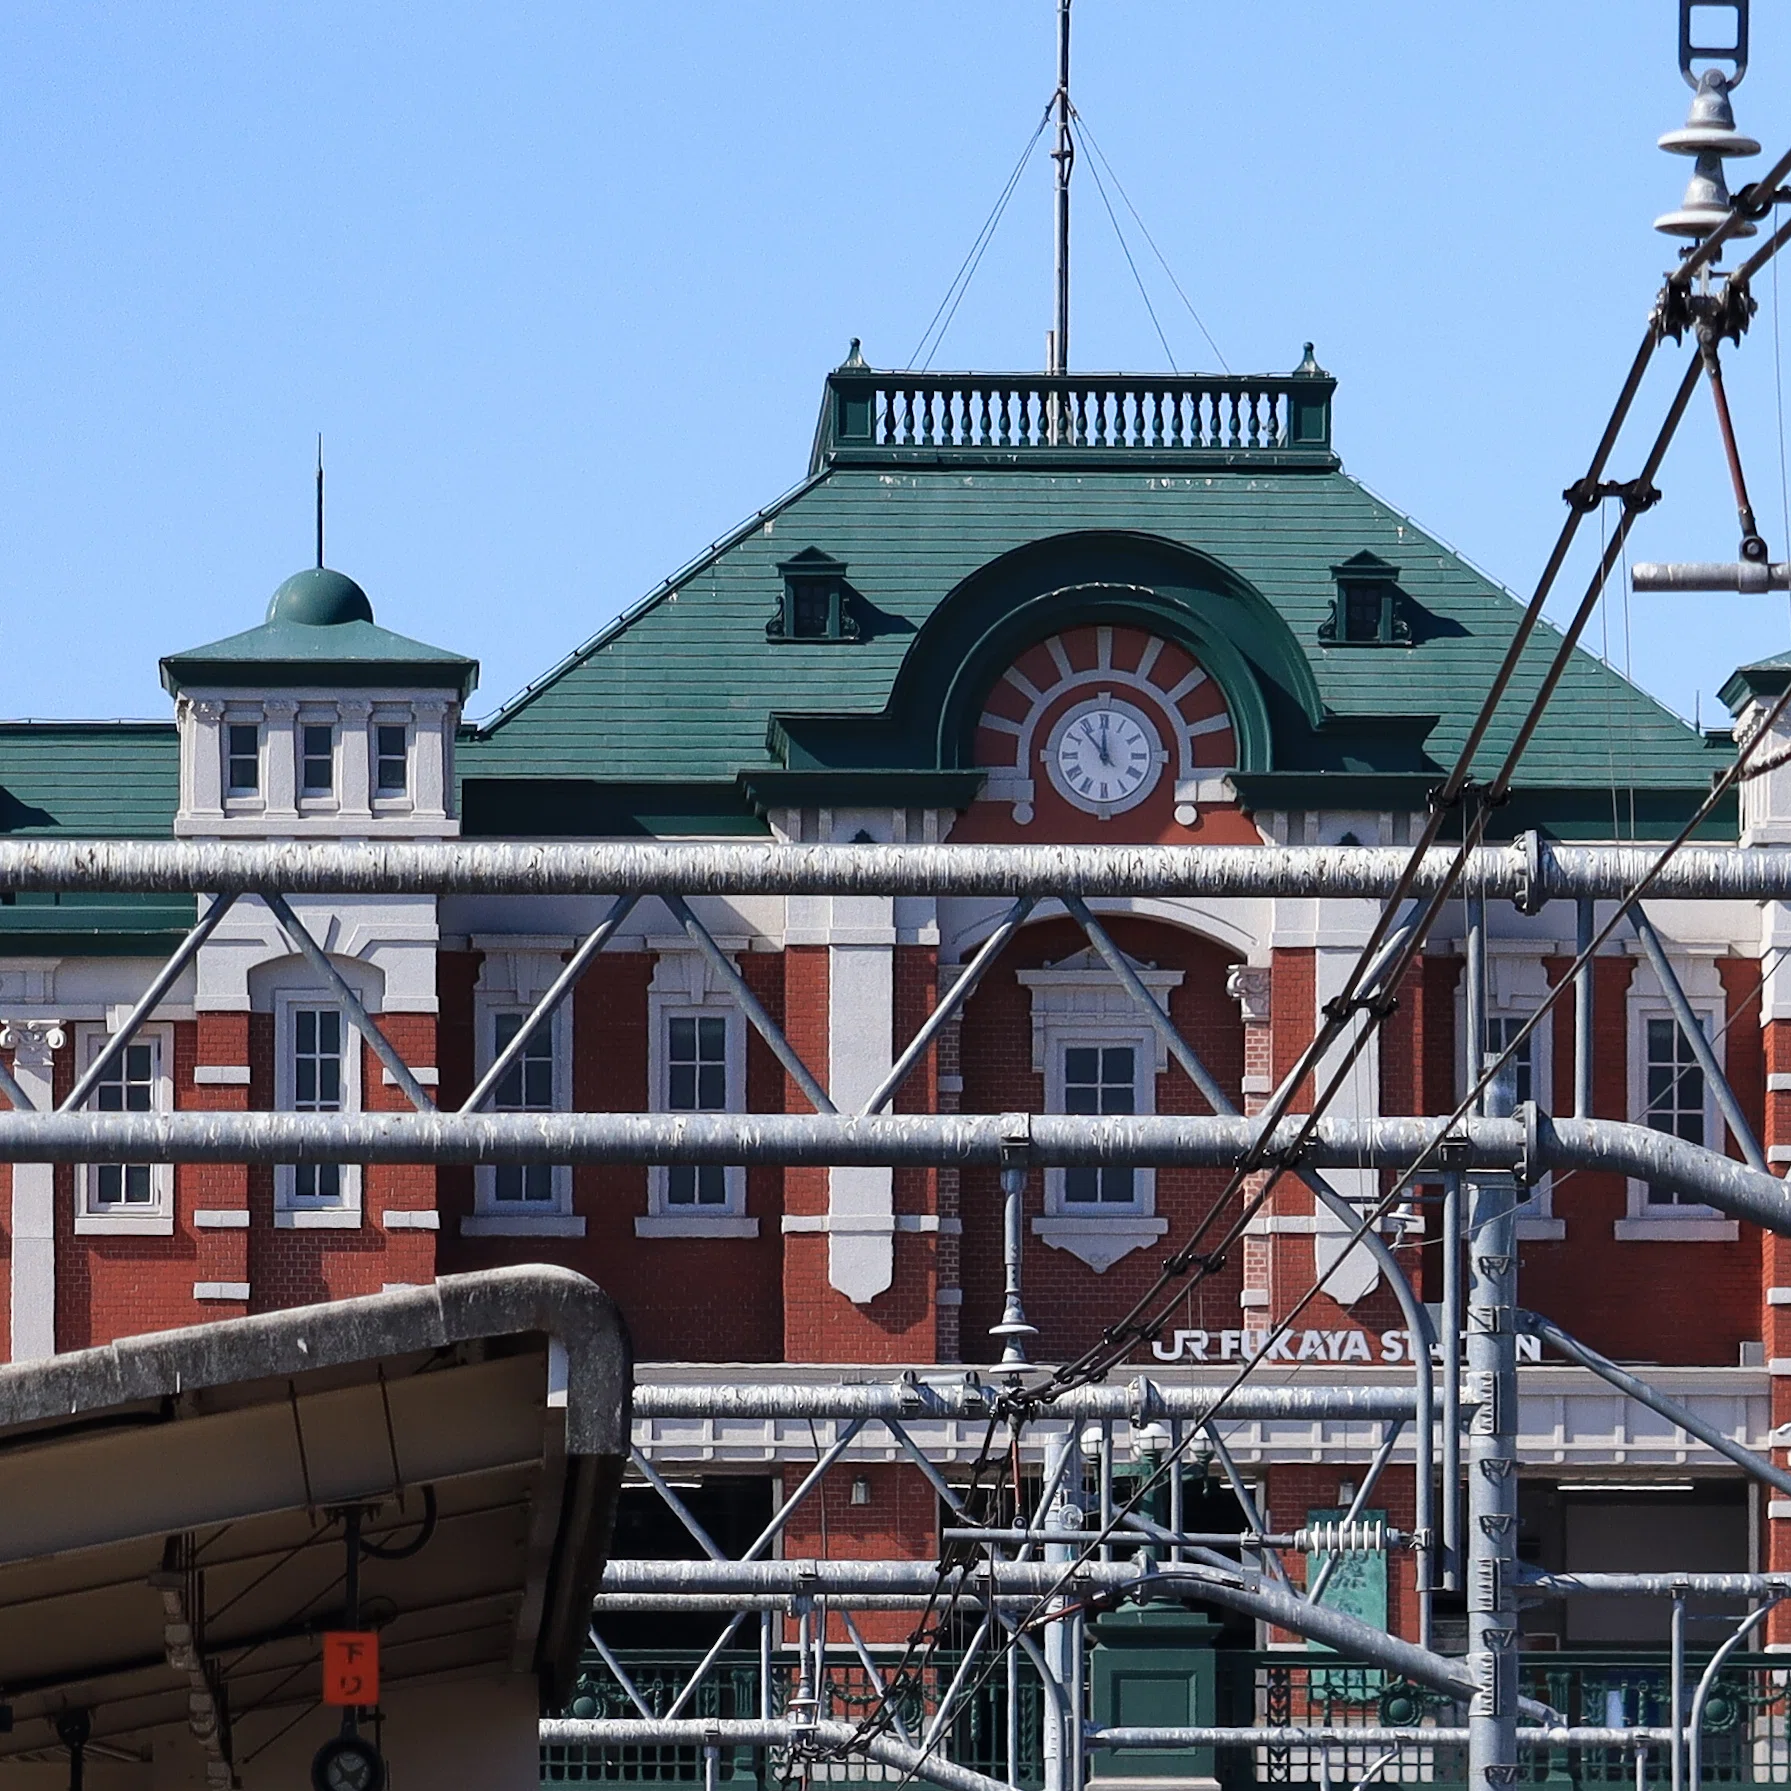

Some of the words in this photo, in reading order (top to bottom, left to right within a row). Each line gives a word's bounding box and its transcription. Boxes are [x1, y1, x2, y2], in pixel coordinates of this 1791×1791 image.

[1152, 1329, 1210, 1361] JR
[1220, 1329, 1373, 1361] FUKAYA
[336, 1641, 365, 1697] 下り
